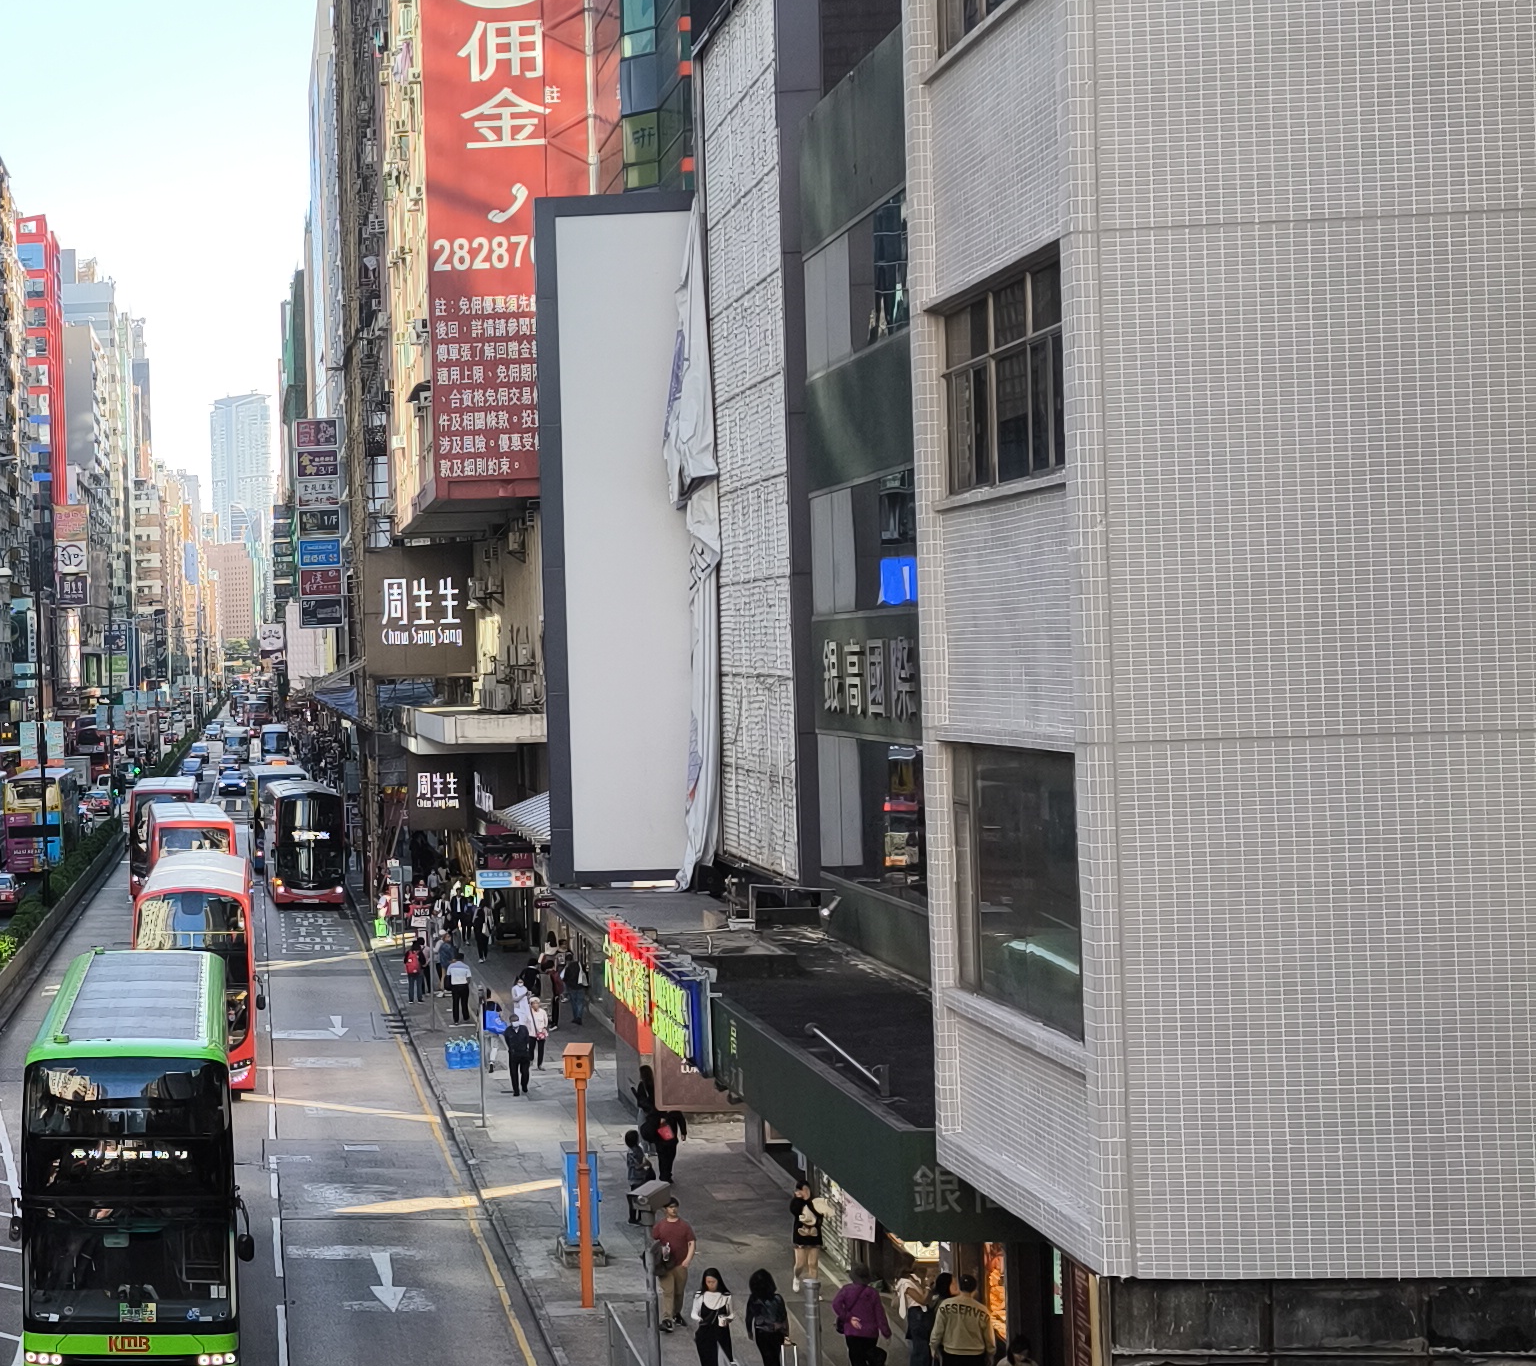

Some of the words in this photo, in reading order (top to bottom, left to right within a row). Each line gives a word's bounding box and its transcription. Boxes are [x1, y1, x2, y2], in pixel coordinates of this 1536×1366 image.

[433, 235, 535, 272] 28287
[382, 577, 461, 625] 周生生
[382, 628, 409, 645] Chow
[411, 626, 436, 646] Sang
[437, 627, 463, 646] Sang
[416, 772, 459, 798] 周生生
[108, 1336, 150, 1352] KMB
